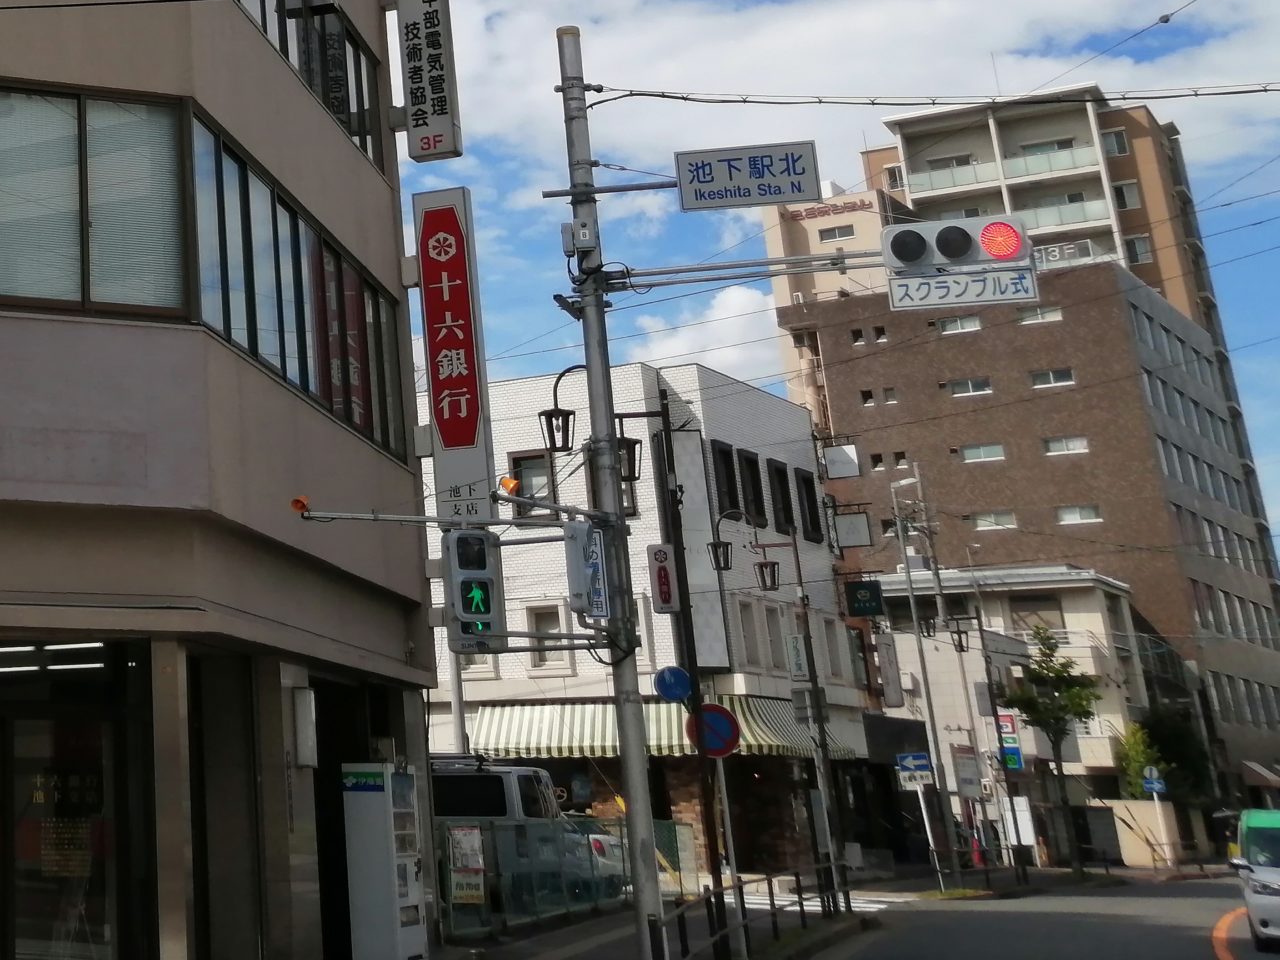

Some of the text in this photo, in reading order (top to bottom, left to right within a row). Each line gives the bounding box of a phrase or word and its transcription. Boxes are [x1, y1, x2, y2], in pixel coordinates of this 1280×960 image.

[420, 135, 444, 151] 3F
[687, 151, 806, 185] 池下駅北
[694, 183, 752, 202] Ikeshita
[758, 183, 786, 197] Sta.
[897, 273, 1030, 303] スクランブル式
[428, 271, 472, 420] 十六銀行
[453, 502, 478, 516] 支店
